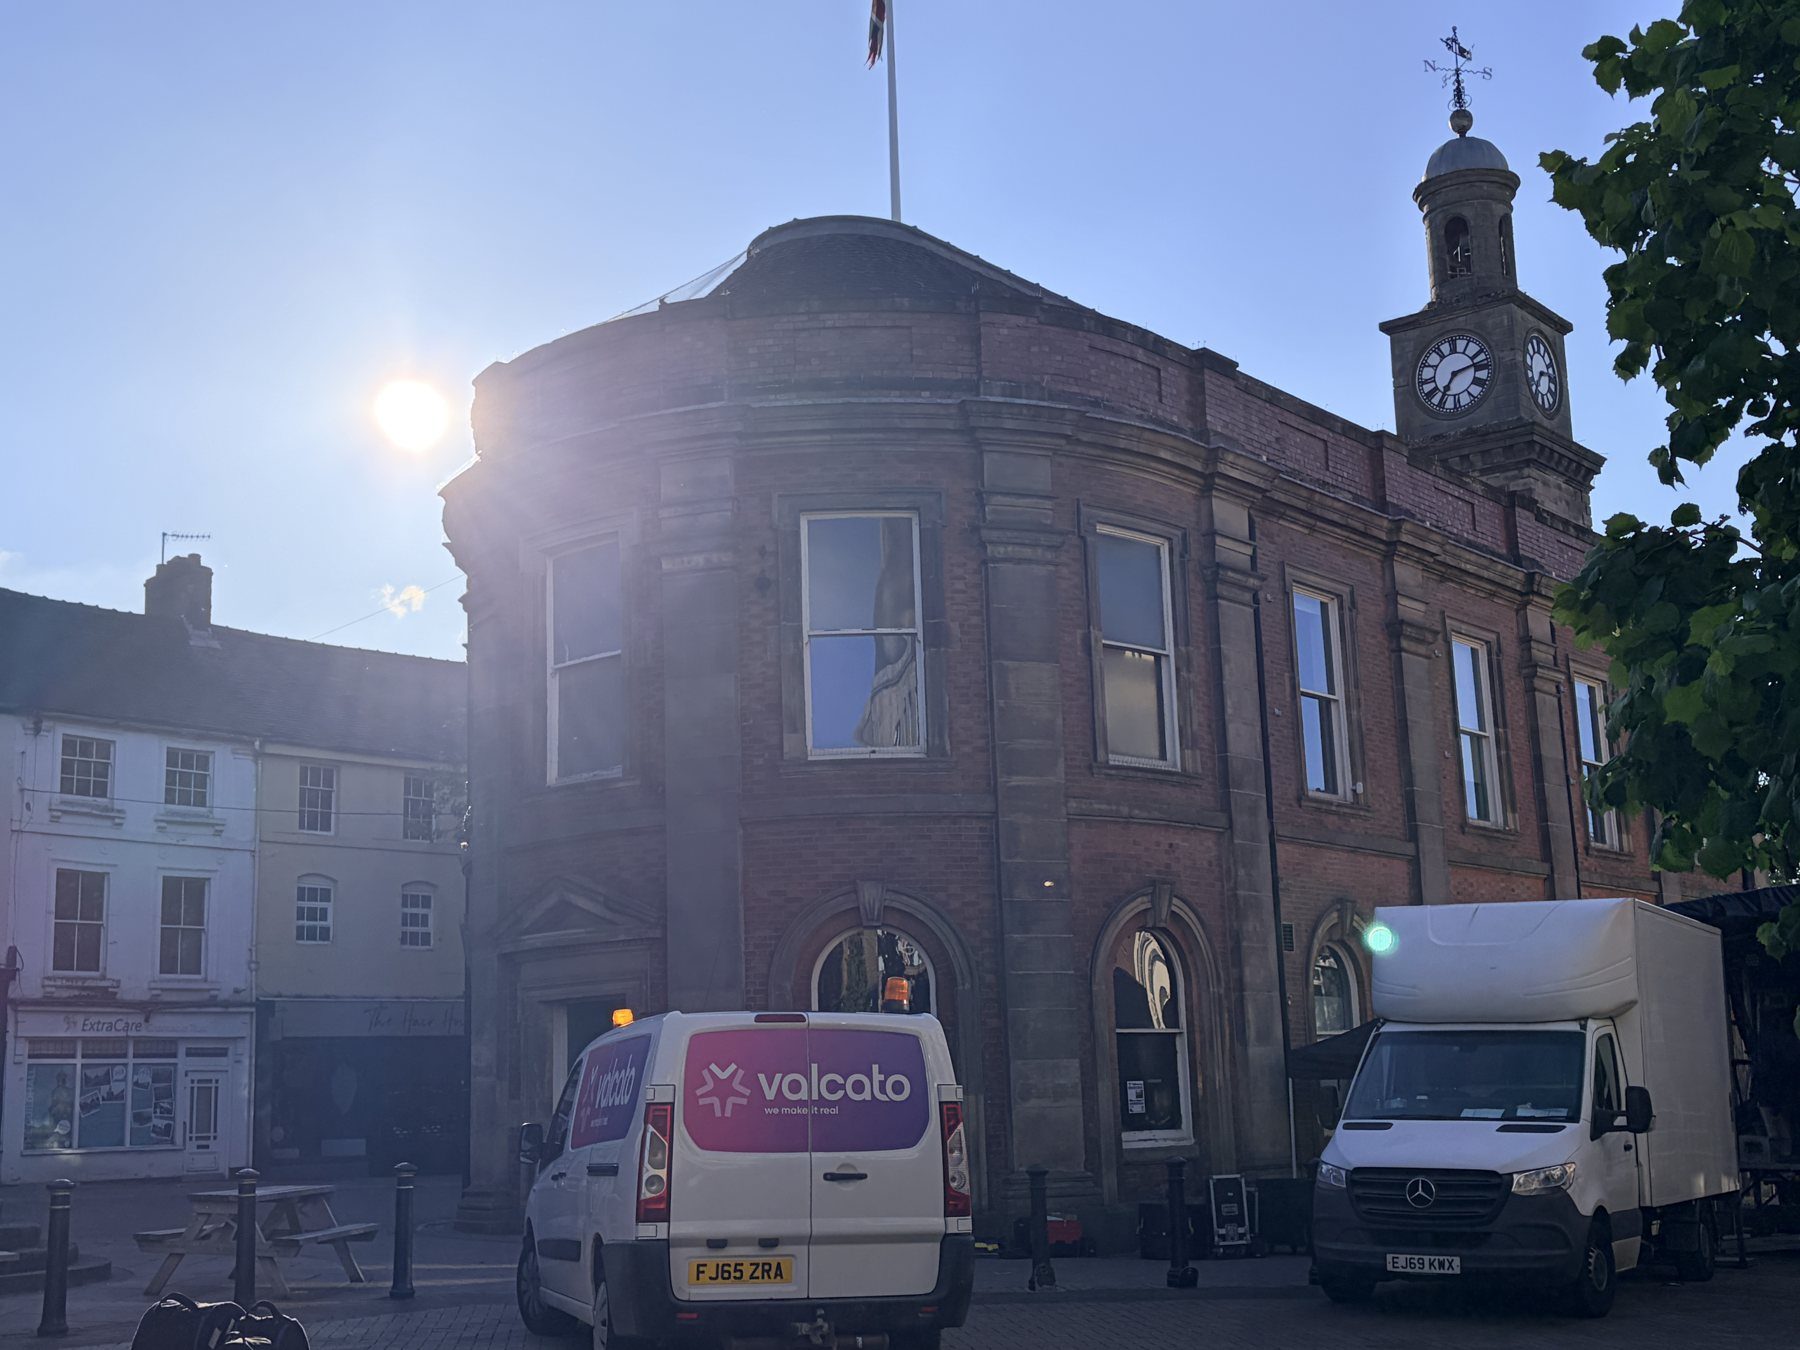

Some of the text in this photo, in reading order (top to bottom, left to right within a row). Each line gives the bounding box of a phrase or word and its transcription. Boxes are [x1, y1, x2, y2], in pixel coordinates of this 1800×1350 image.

[1423, 60, 1436, 72] N
[1483, 67, 1493, 81] S
[81, 1018, 143, 1032] ExtraCare
[363, 1004, 392, 1033] The
[757, 1063, 911, 1102] valcato
[781, 1106, 808, 1115] make
[811, 1106, 818, 1115] it
[820, 1106, 839, 1115] real
[696, 1261, 784, 1281] FJ65 ZRA
[1391, 1255, 1455, 1272] EJ69 KWX
